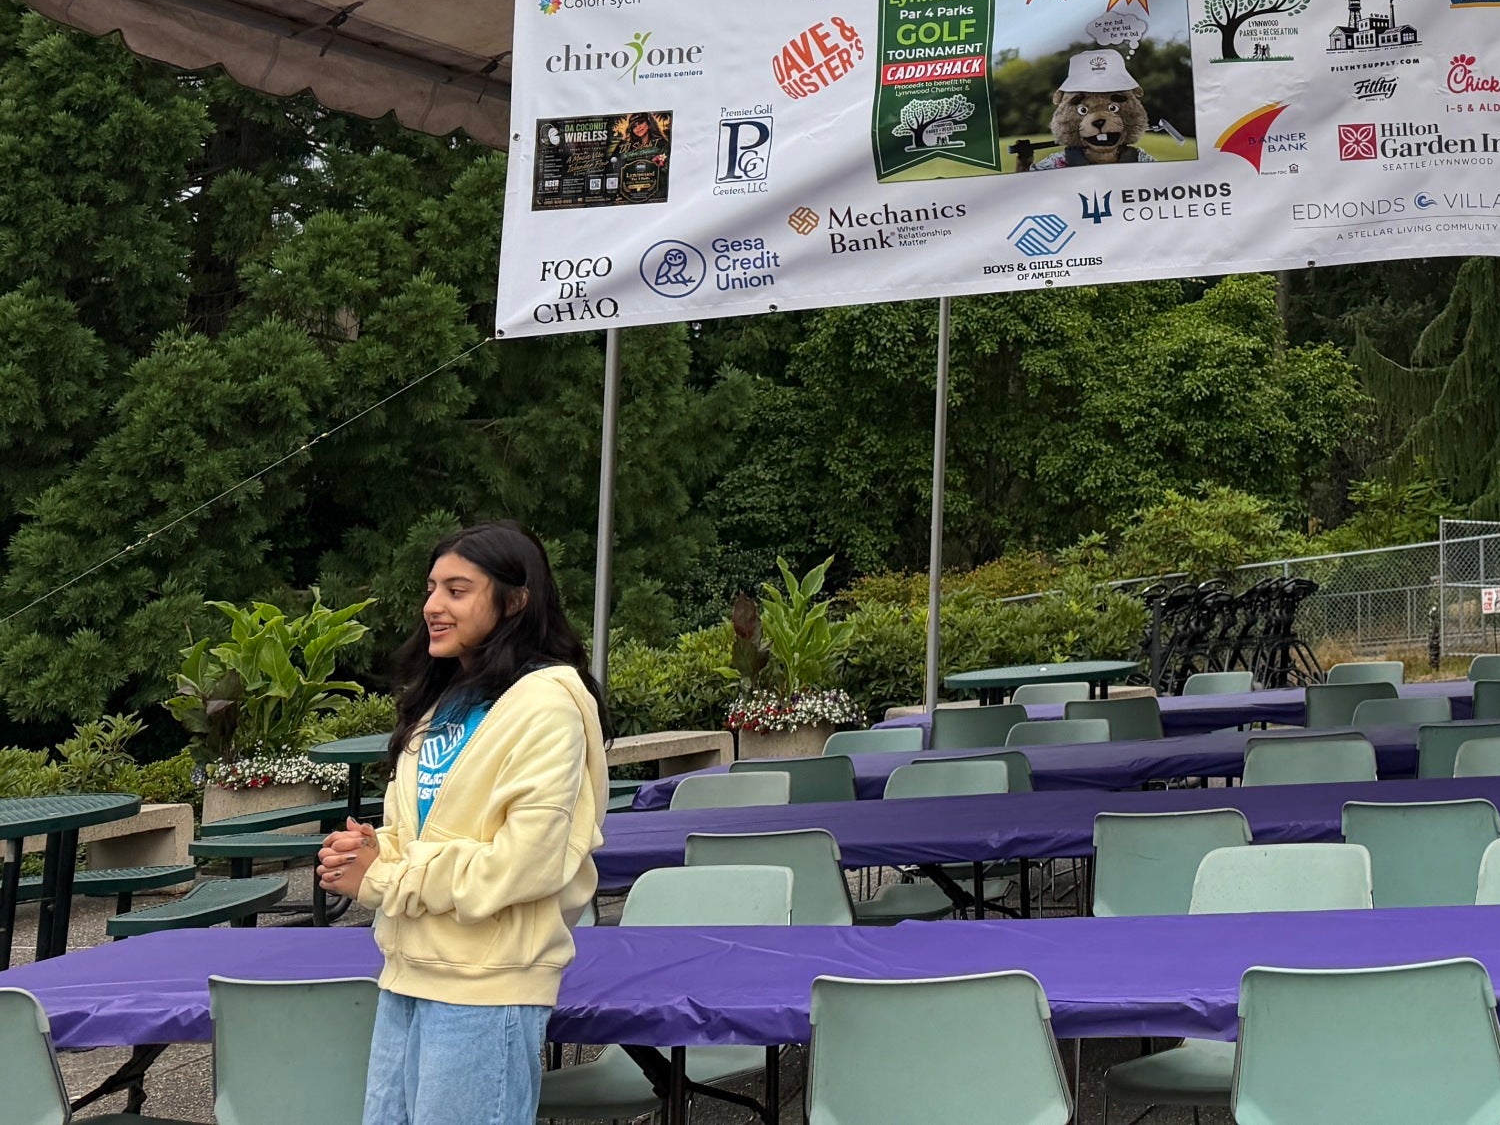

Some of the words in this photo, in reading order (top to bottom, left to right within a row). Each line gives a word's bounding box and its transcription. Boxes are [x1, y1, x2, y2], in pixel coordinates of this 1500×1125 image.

[900, 10, 921, 20] Par
[924, 8, 934, 18] 4
[937, 4, 974, 17] Parks
[896, 19, 976, 45] GOLF
[1239, 29, 1258, 37] PARKS
[1263, 27, 1299, 36] RECREATION
[1248, 19, 1279, 28] LYNNWOOD
[772, 22, 840, 84] DAVE
[830, 16, 860, 42] &
[886, 43, 983, 61] TOURNAMENT
[781, 37, 864, 100] BUSTER'S
[886, 58, 982, 81] CADDYSHACK
[1331, 58, 1420, 72] FILTHYSUPPLY.COM
[639, 71, 671, 80] wellness
[674, 69, 703, 77] centers
[895, 88, 929, 97] Lynnwood
[931, 85, 963, 93] Chamber
[1354, 76, 1398, 99] Filthy
[720, 106, 753, 118] Premier
[753, 104, 773, 115] Golf
[1467, 103, 1474, 112] &
[576, 121, 608, 131] COCONUT
[1380, 122, 1439, 137] Hilton
[564, 130, 608, 143] WIRELESS
[1248, 132, 1306, 145] BANNER
[1268, 142, 1307, 152] BANK
[1380, 135, 1477, 158] Garden
[713, 184, 745, 197] Centers,
[1121, 182, 1232, 204] EDMONDS
[828, 202, 966, 229] Mechanics
[1122, 201, 1232, 222] COLLEGE
[1292, 197, 1405, 220] EDMONDS
[896, 225, 925, 233] Where
[898, 229, 952, 240] Relationships
[1337, 233, 1344, 241] A
[1347, 228, 1393, 239] STELLAR
[1397, 224, 1432, 234] LIVING
[1435, 223, 1498, 232] COMMUNITY
[712, 236, 765, 253] Gesa
[829, 229, 894, 254] Bank
[899, 239, 927, 247] Matter
[540, 256, 612, 282] FOGO
[715, 250, 780, 271] Credit
[983, 264, 1014, 275] BOYS
[1017, 263, 1026, 271] &
[1029, 259, 1063, 270] GIRLS
[1066, 257, 1103, 267] CLUBS
[716, 272, 774, 291] Union
[1017, 273, 1030, 281] OF
[1031, 270, 1070, 279] AMERICA
[559, 281, 587, 300] DE
[533, 296, 618, 324] CHÃO
